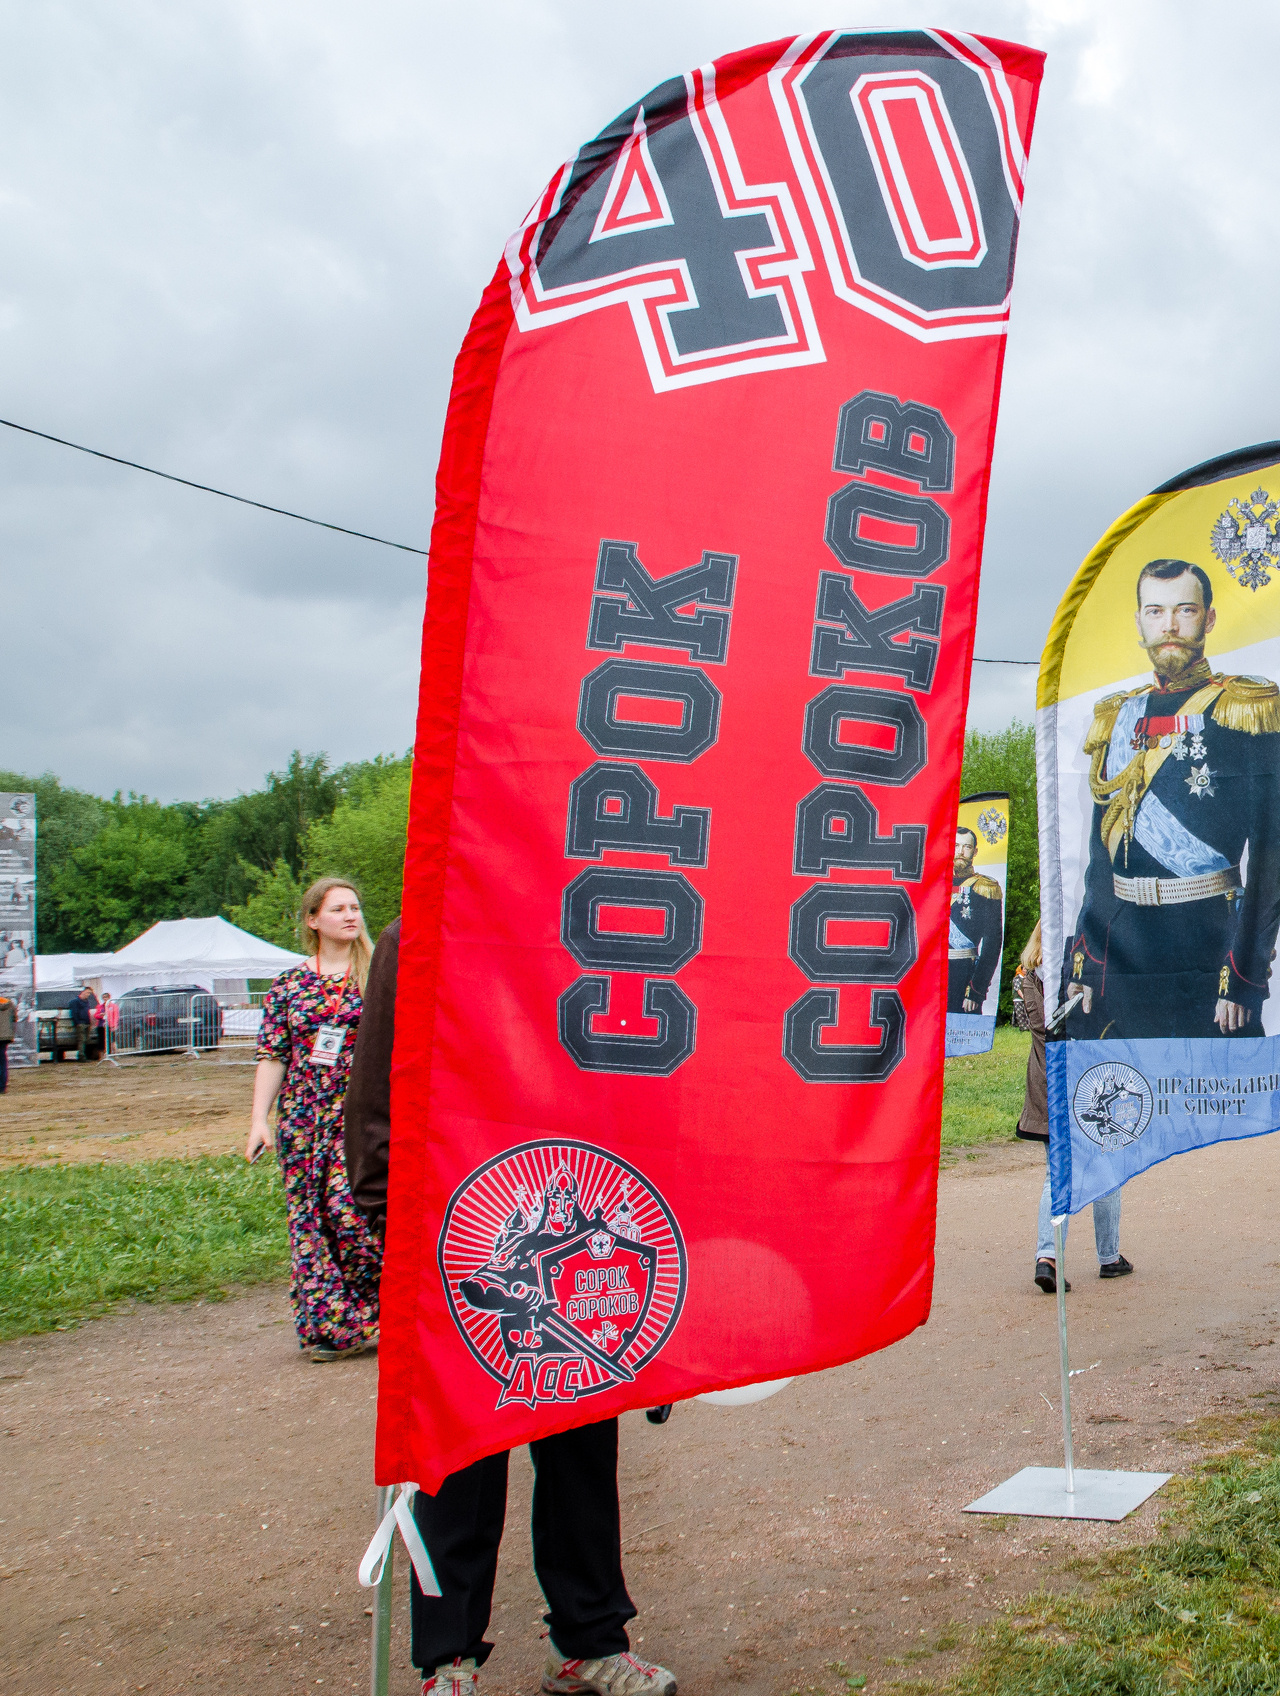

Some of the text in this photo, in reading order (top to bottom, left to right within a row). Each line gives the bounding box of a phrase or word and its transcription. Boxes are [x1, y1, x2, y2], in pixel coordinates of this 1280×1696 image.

[508, 27, 1026, 393] 40
[557, 538, 740, 1077] СОРОК
[782, 389, 957, 1084] СОРОКОВ
[1157, 1098, 1170, 1116] И
[1184, 1098, 1247, 1116] СПОРТ
[566, 1292, 639, 1322] СОРОКОВ
[574, 1265, 630, 1293] СОРОК
